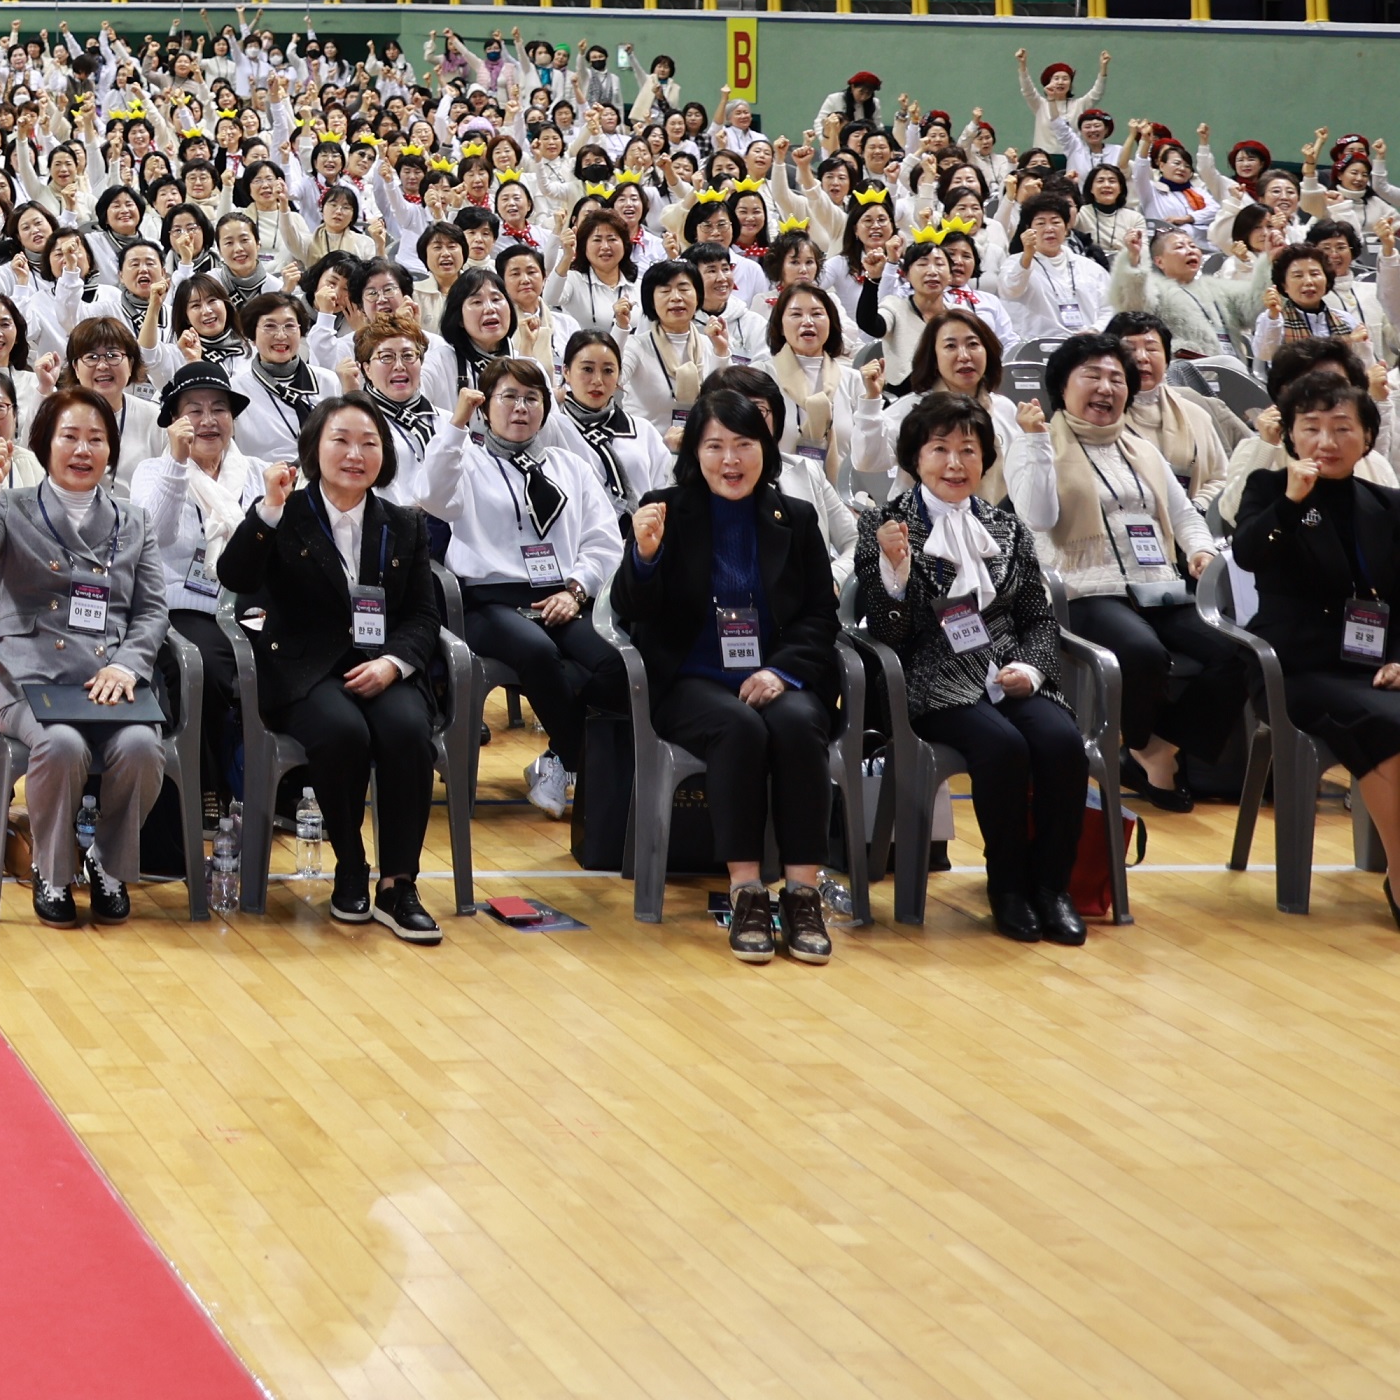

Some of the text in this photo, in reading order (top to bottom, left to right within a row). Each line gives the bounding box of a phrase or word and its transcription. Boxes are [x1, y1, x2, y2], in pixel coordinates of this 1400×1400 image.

[733, 31, 753, 89] B
[283, 390, 300, 405] H
[403, 407, 418, 429] H
[584, 427, 608, 446] H
[513, 450, 535, 472] H
[530, 565, 554, 574] 국순화
[74, 607, 102, 619] 이정한
[358, 627, 381, 636] 한무경
[952, 626, 980, 641] 이민재
[728, 648, 755, 658] 윤명희
